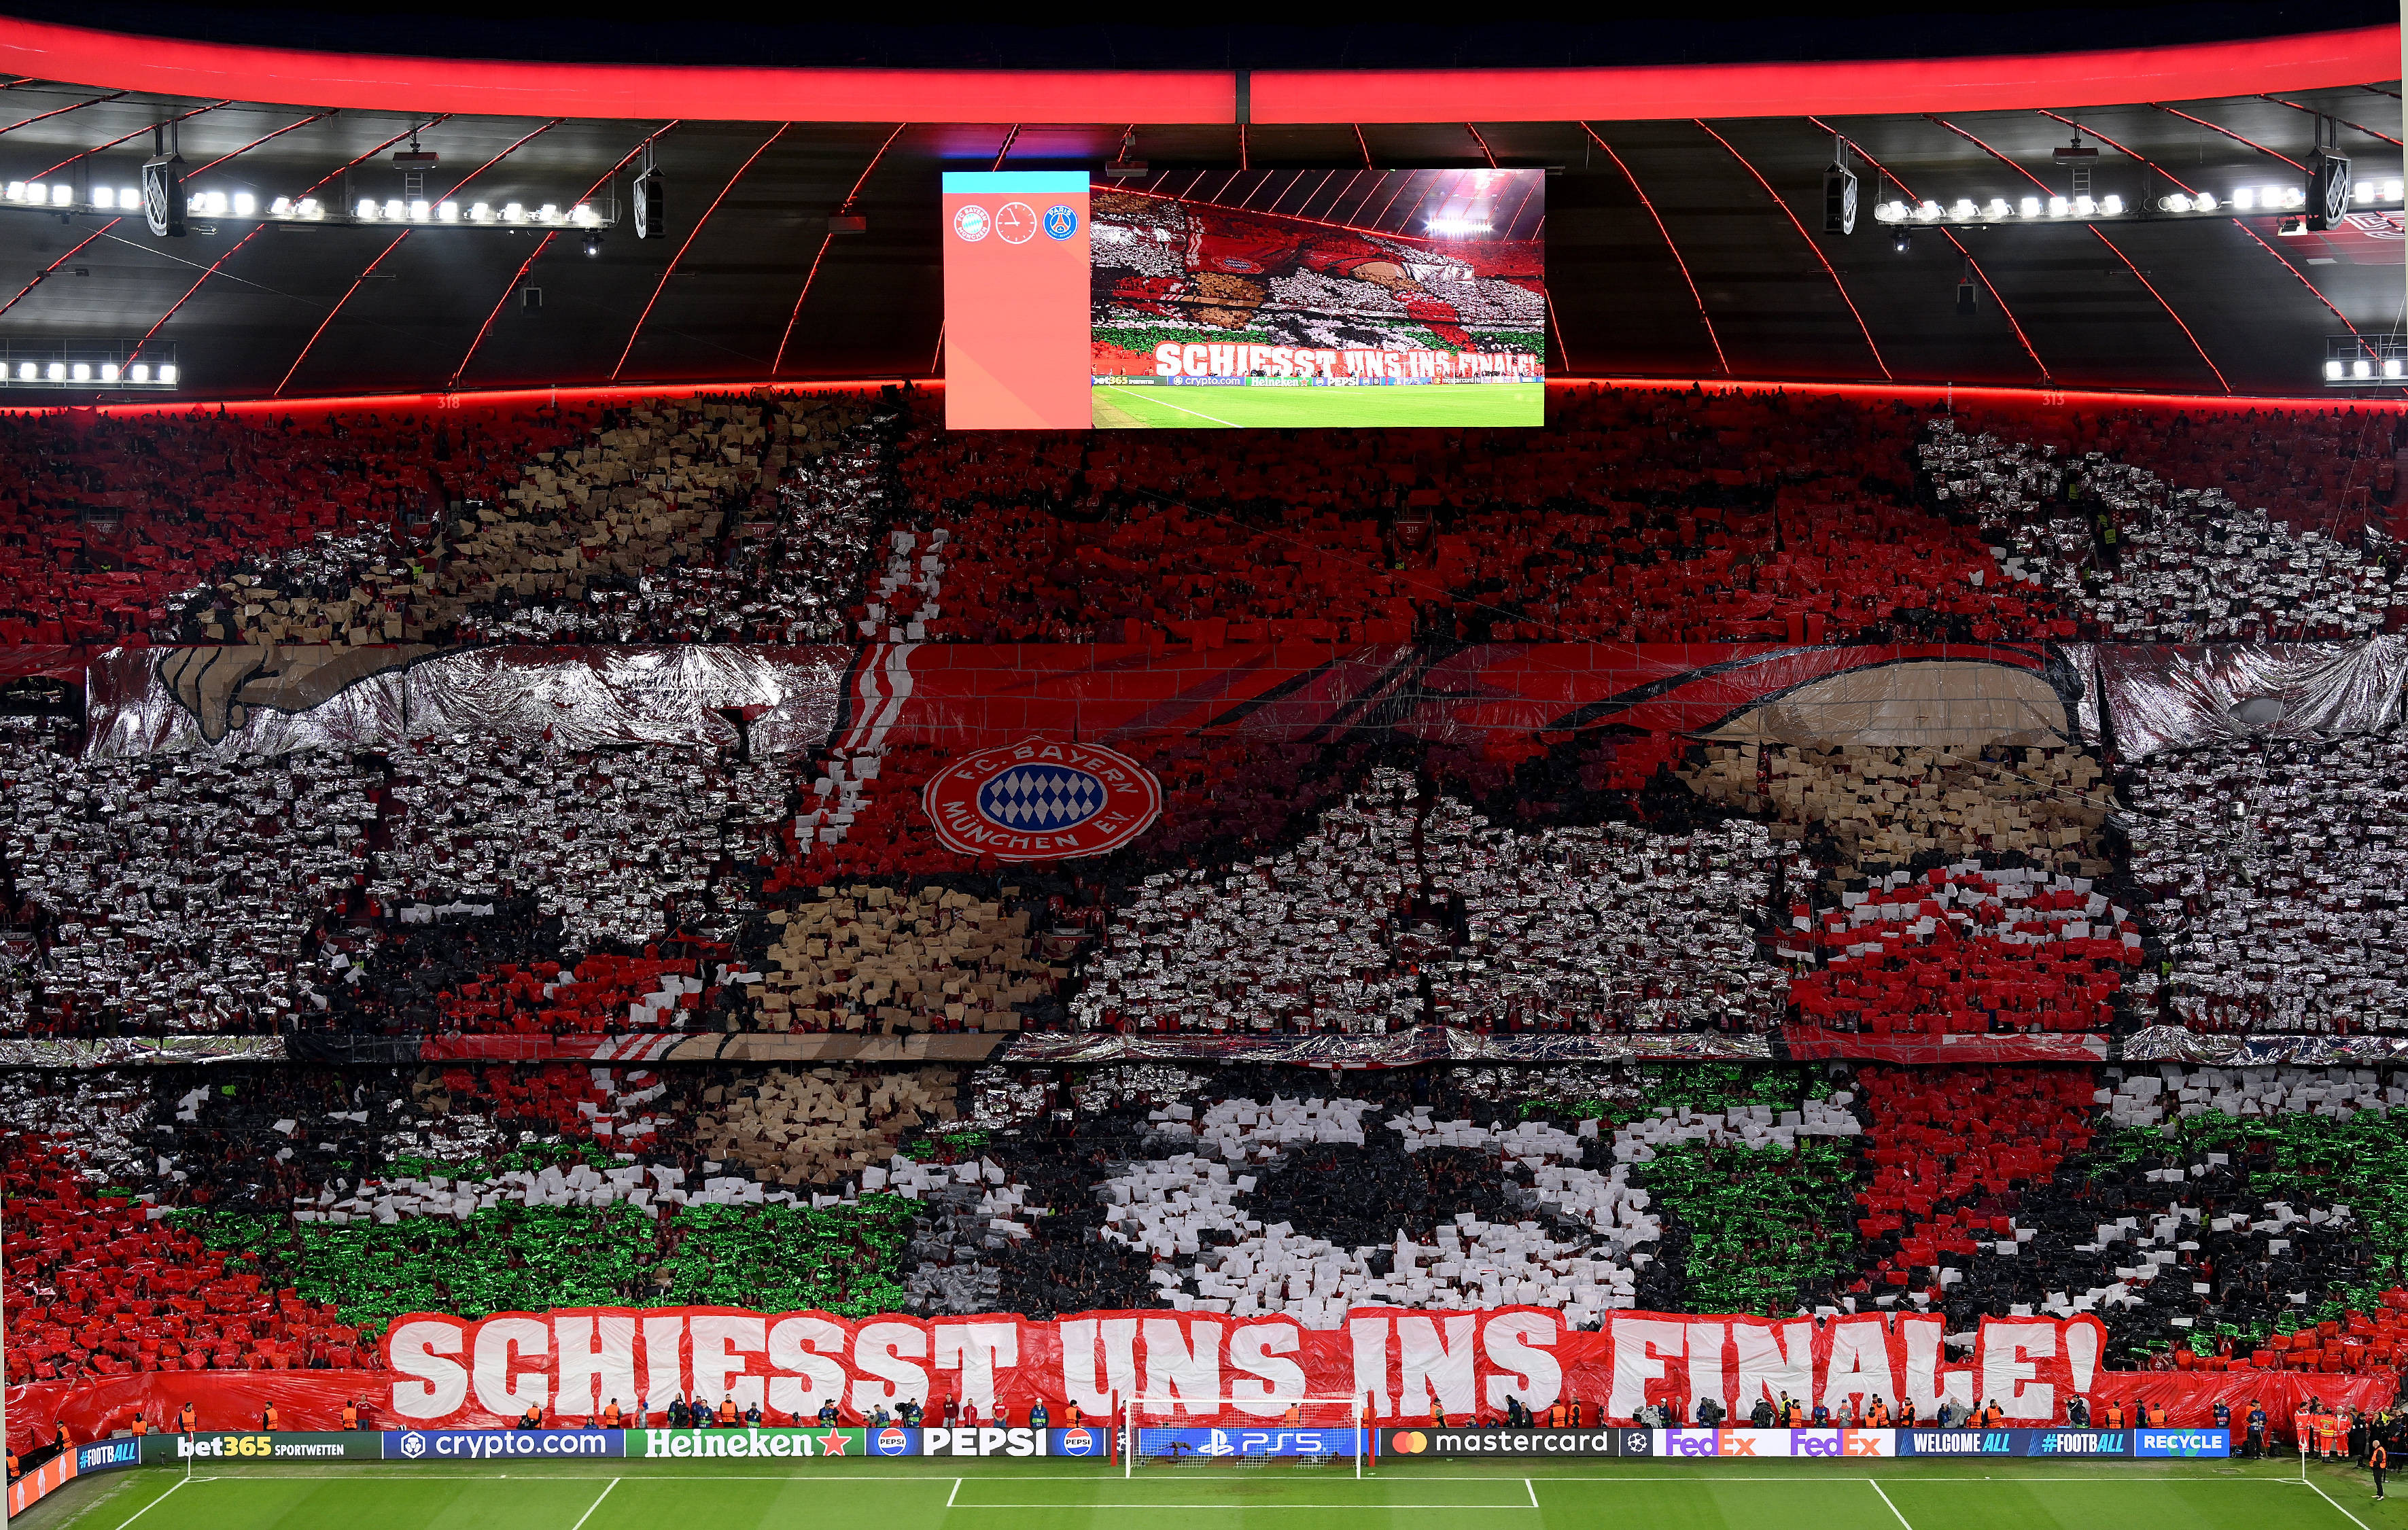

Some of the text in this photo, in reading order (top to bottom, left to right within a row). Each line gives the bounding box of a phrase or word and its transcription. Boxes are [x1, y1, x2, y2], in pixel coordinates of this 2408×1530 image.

[964, 207, 988, 221] BAYERN
[1049, 207, 1072, 216] PARIS
[1156, 343, 1336, 377] SCHIESST
[1344, 351, 1401, 377] UNS
[1408, 351, 1451, 377] INS
[1185, 377, 1240, 387] crypto.com
[1251, 377, 1299, 386] Heineken
[1328, 377, 1359, 386] PEPSI
[438, 396, 460, 408] 318
[2042, 393, 2065, 406] 313
[752, 527, 765, 535] 317
[1012, 745, 1139, 794] BAYERN
[942, 801, 1079, 850] MÜNCHEN
[1777, 940, 1790, 948] 219
[390, 1312, 2097, 1422] SCHIESST UNS INS FINALE!
[177, 1436, 344, 1457] bet365 SPORTWETTEN
[436, 1431, 606, 1459] crypto.com
[645, 1428, 814, 1457] Heineken
[923, 1427, 1047, 1457] PEPSI
[1242, 1433, 1322, 1451] PS5
[1436, 1431, 1607, 1451] mastercard
[1666, 1428, 1756, 1456] FedEx
[1791, 1428, 1881, 1456] FedEx
[1913, 1433, 2010, 1453] WELCOME ALL
[2041, 1433, 2125, 1453] #FOOTBALL
[2144, 1436, 2222, 1449] RECYCLE
[80, 1442, 136, 1469] #FOOTBALL
